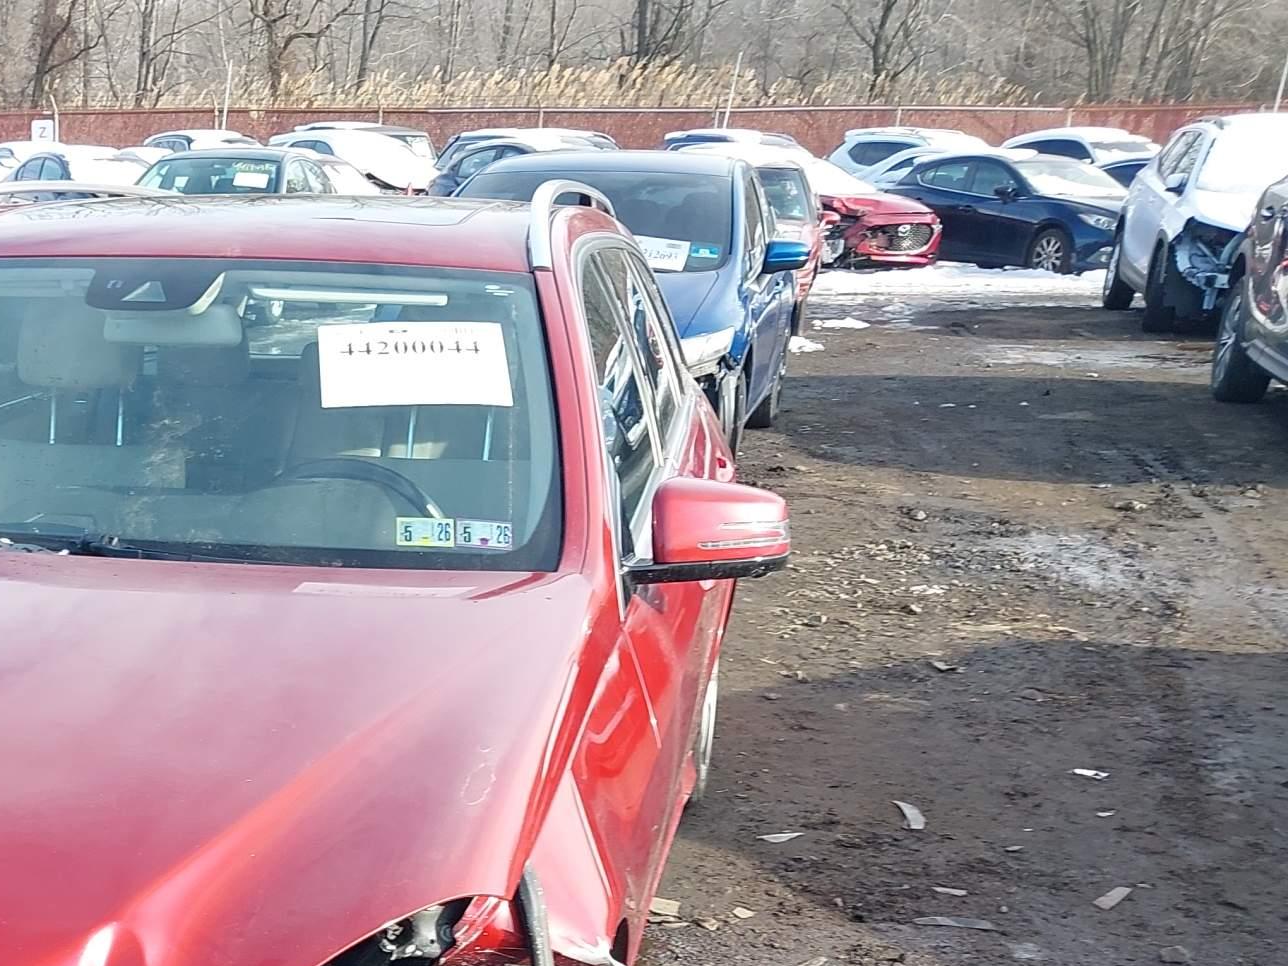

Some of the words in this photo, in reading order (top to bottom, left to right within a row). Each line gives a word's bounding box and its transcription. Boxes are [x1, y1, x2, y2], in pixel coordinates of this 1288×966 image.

[340, 340, 481, 356] 44200044
[404, 525, 412, 542] 5
[437, 522, 451, 541] 26
[463, 526, 471, 543] 5
[496, 525, 510, 544] 26
